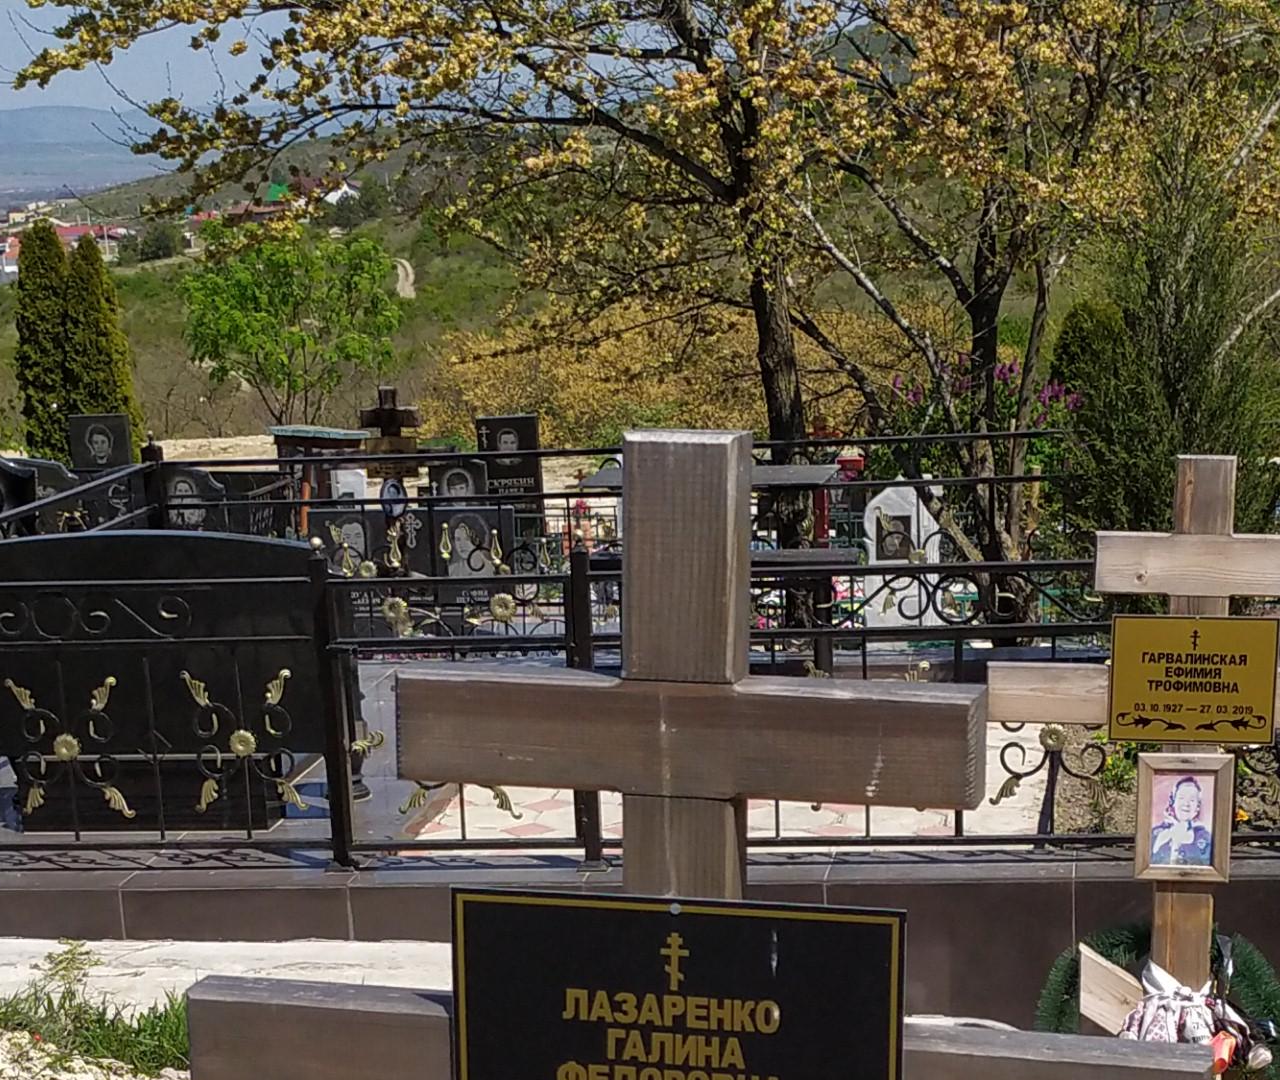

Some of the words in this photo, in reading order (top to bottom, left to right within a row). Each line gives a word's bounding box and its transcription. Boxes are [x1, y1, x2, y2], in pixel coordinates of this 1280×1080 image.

[1141, 652, 1248, 666] ГАРВАЛИНСКАЯ
[1164, 666, 1222, 680] ЕФИМИЯ
[1147, 680, 1240, 693] ТРОФИМОВНА
[562, 987, 781, 1034] ЛАЗАРЕНКО
[606, 1027, 746, 1070] ГАЛИНА
